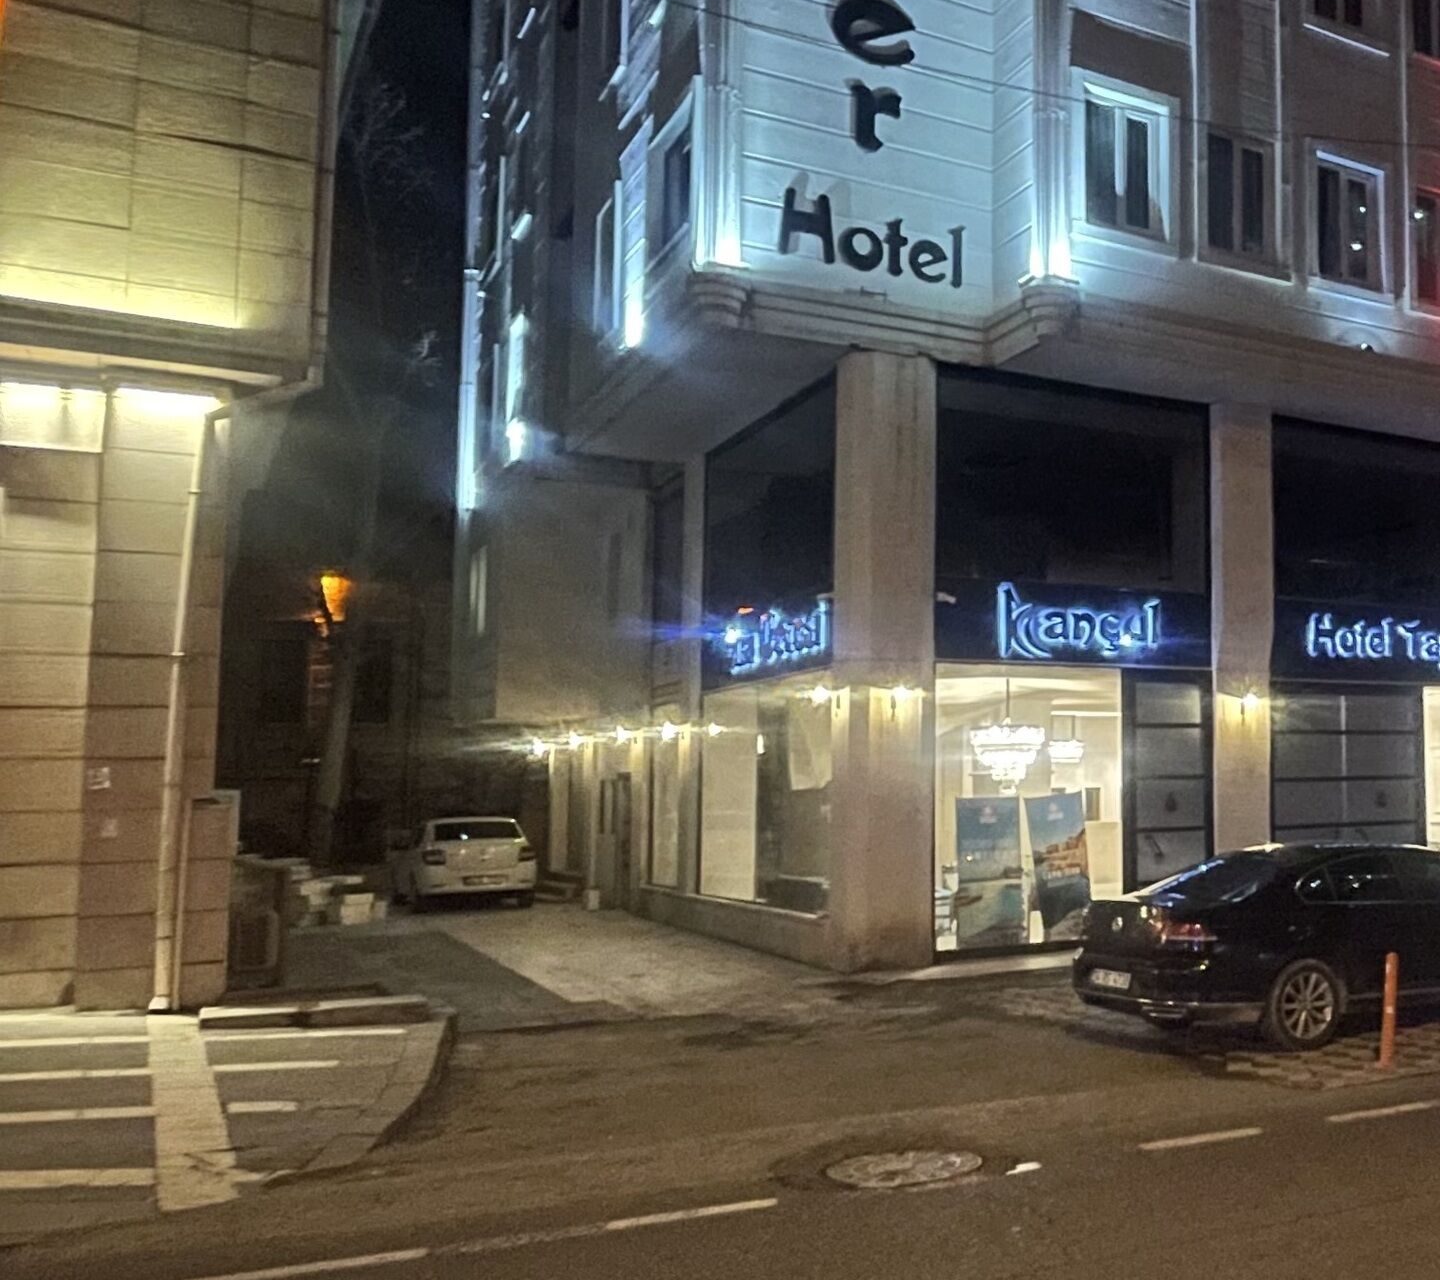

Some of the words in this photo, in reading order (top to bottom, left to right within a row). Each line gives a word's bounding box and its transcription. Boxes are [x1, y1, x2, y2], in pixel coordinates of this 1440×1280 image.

[777, 180, 967, 289] Hotel
[997, 581, 1161, 659] Kançul
[1305, 612, 1393, 659] Hotel
